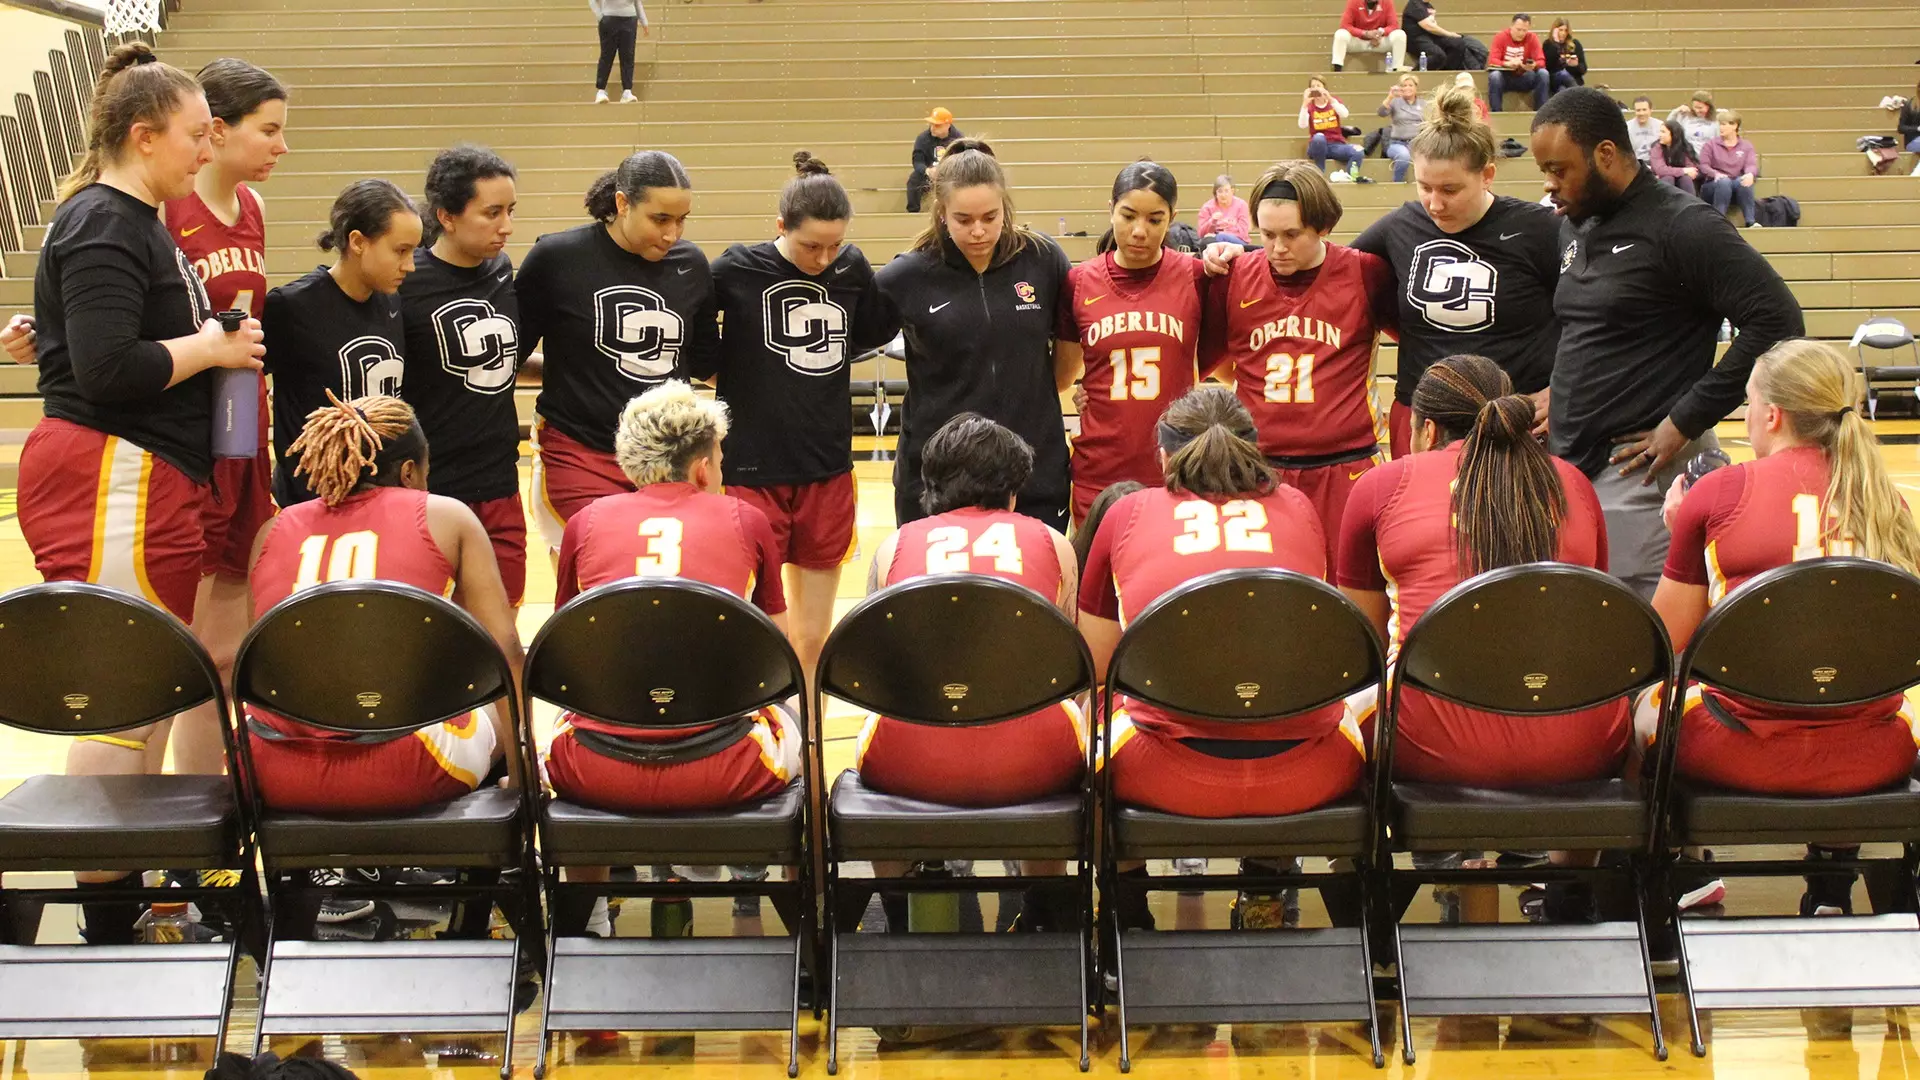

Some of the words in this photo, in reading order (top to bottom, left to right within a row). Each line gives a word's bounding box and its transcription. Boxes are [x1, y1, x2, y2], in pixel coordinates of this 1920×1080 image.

[1087, 311, 1184, 347] OBERLIN
[1250, 315, 1342, 350] OBERLIN
[1109, 347, 1162, 401] 15
[1264, 353, 1316, 404] 21
[635, 516, 684, 577] 3
[925, 522, 1024, 576] 24
[1173, 499, 1274, 556] 32
[292, 529, 379, 595] 10
